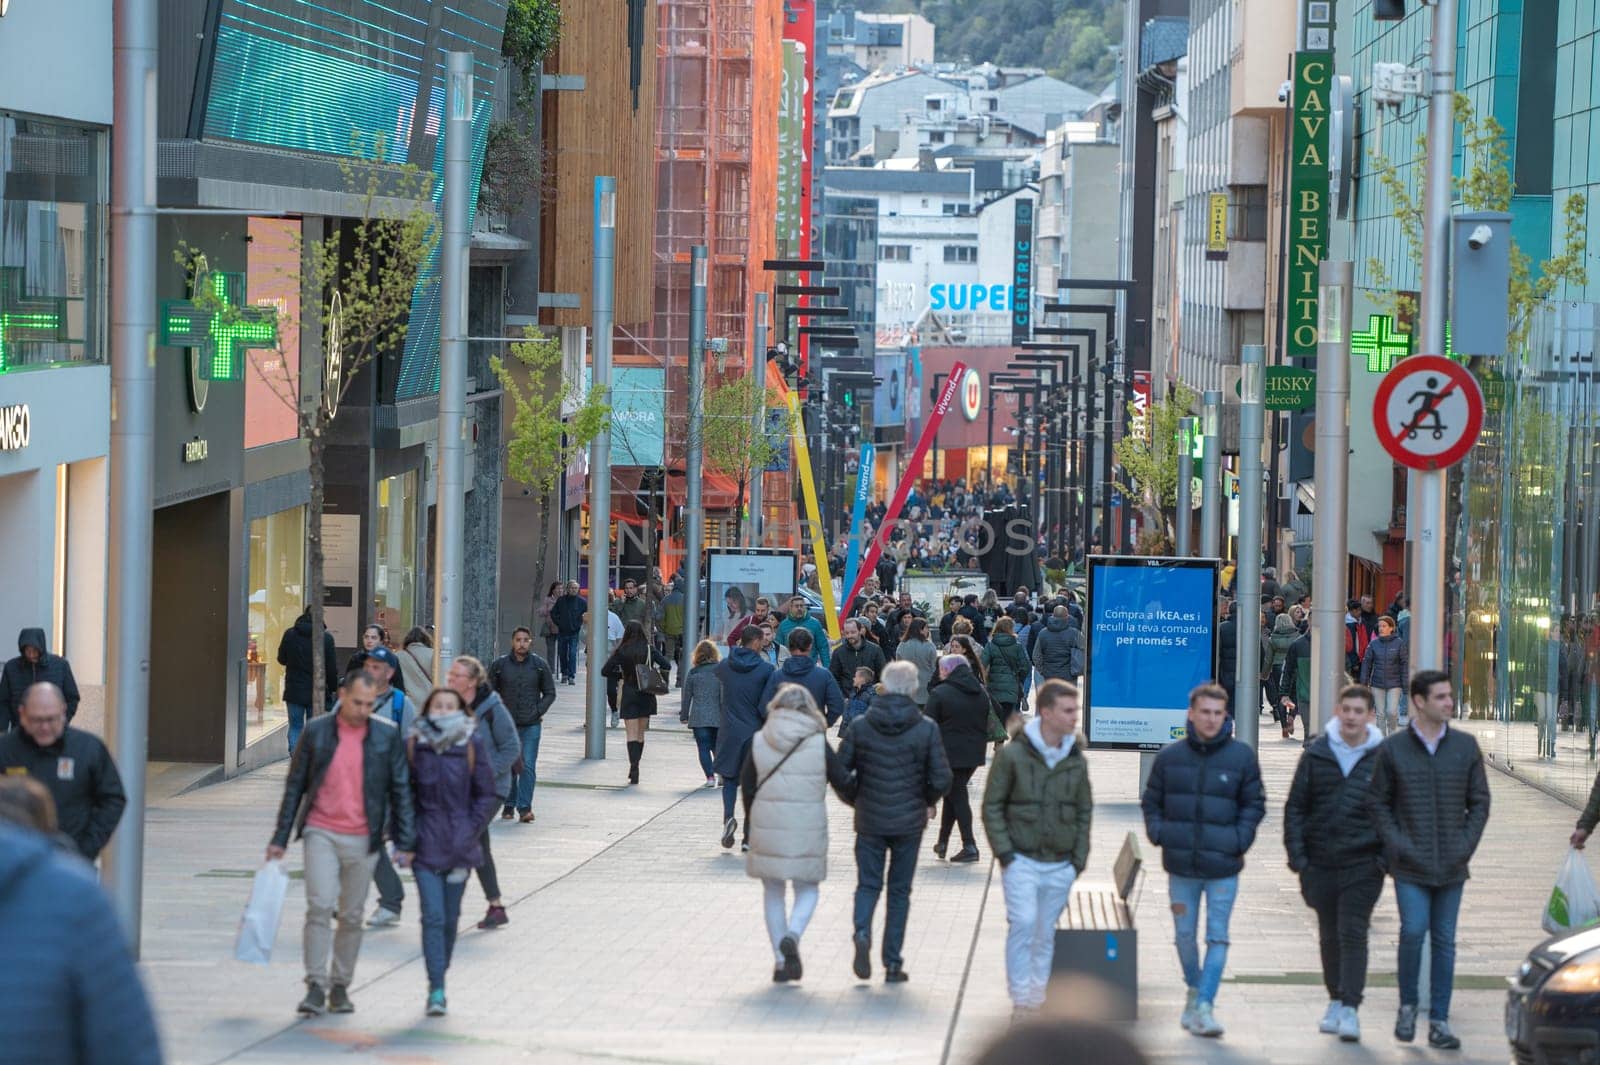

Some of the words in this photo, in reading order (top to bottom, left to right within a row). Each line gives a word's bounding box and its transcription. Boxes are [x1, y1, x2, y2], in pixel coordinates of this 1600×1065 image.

[1299, 63, 1324, 165] CAVA
[1294, 190, 1321, 347] BENITO
[1015, 241, 1029, 325] CENTRIC
[1264, 376, 1312, 391] HISKY
[937, 379, 957, 415] vivand
[1265, 394, 1301, 405] elecció
[859, 464, 870, 500] vivand
[1105, 609, 1144, 621] Compra
[1156, 610, 1195, 621] IKEA.es
[1197, 612, 1201, 621] i
[1096, 622, 1123, 632] recull
[1126, 623, 1135, 632] la
[1138, 624, 1159, 633] teva
[1161, 624, 1208, 634] comanda
[1116, 637, 1134, 647] per
[1137, 635, 1173, 646] només
[1175, 637, 1188, 646] 5€
